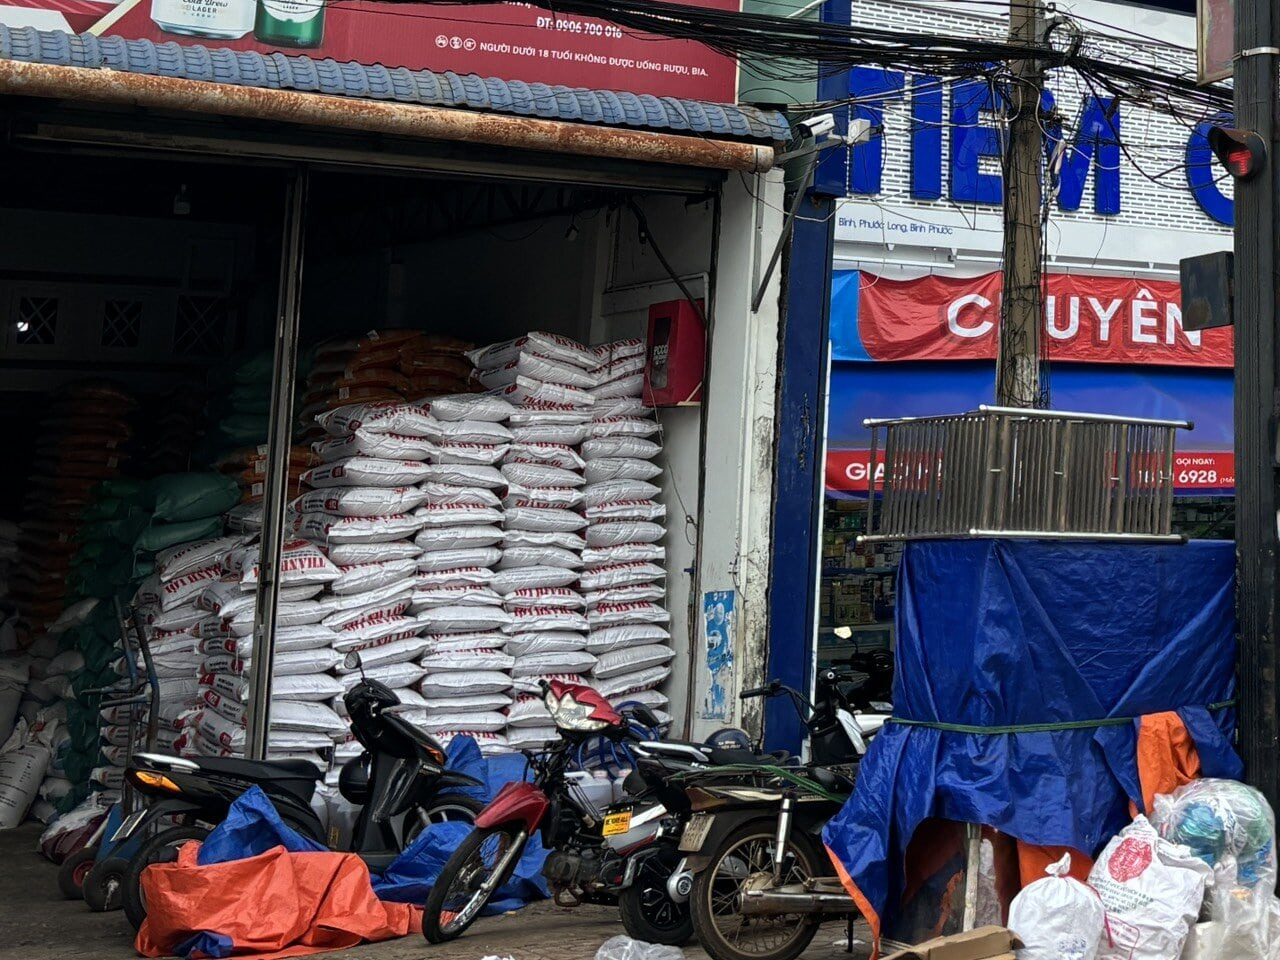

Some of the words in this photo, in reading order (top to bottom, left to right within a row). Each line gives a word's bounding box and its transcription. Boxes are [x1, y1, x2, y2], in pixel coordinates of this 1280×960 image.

[192, 5, 218, 14] LAGER
[556, 19, 582, 34] 0906
[584, 22, 603, 36] 700
[480, 41, 511, 56] NGƯỜI
[513, 42, 536, 57] DƯỚI
[538, 48, 549, 58] 18
[550, 47, 573, 61] TUỔI
[574, 50, 607, 65] KHÔNG
[609, 55, 634, 70] ĐƯỢC
[636, 57, 662, 72] UỐNG
[663, 63, 690, 76] RƯỢU,
[692, 67, 709, 77] BIA.
[887, 222, 908, 233] Long,
[947, 288, 1201, 347] CUYÊN
[1176, 458, 1191, 467] GỌI
[1178, 469, 1217, 483] 6928
